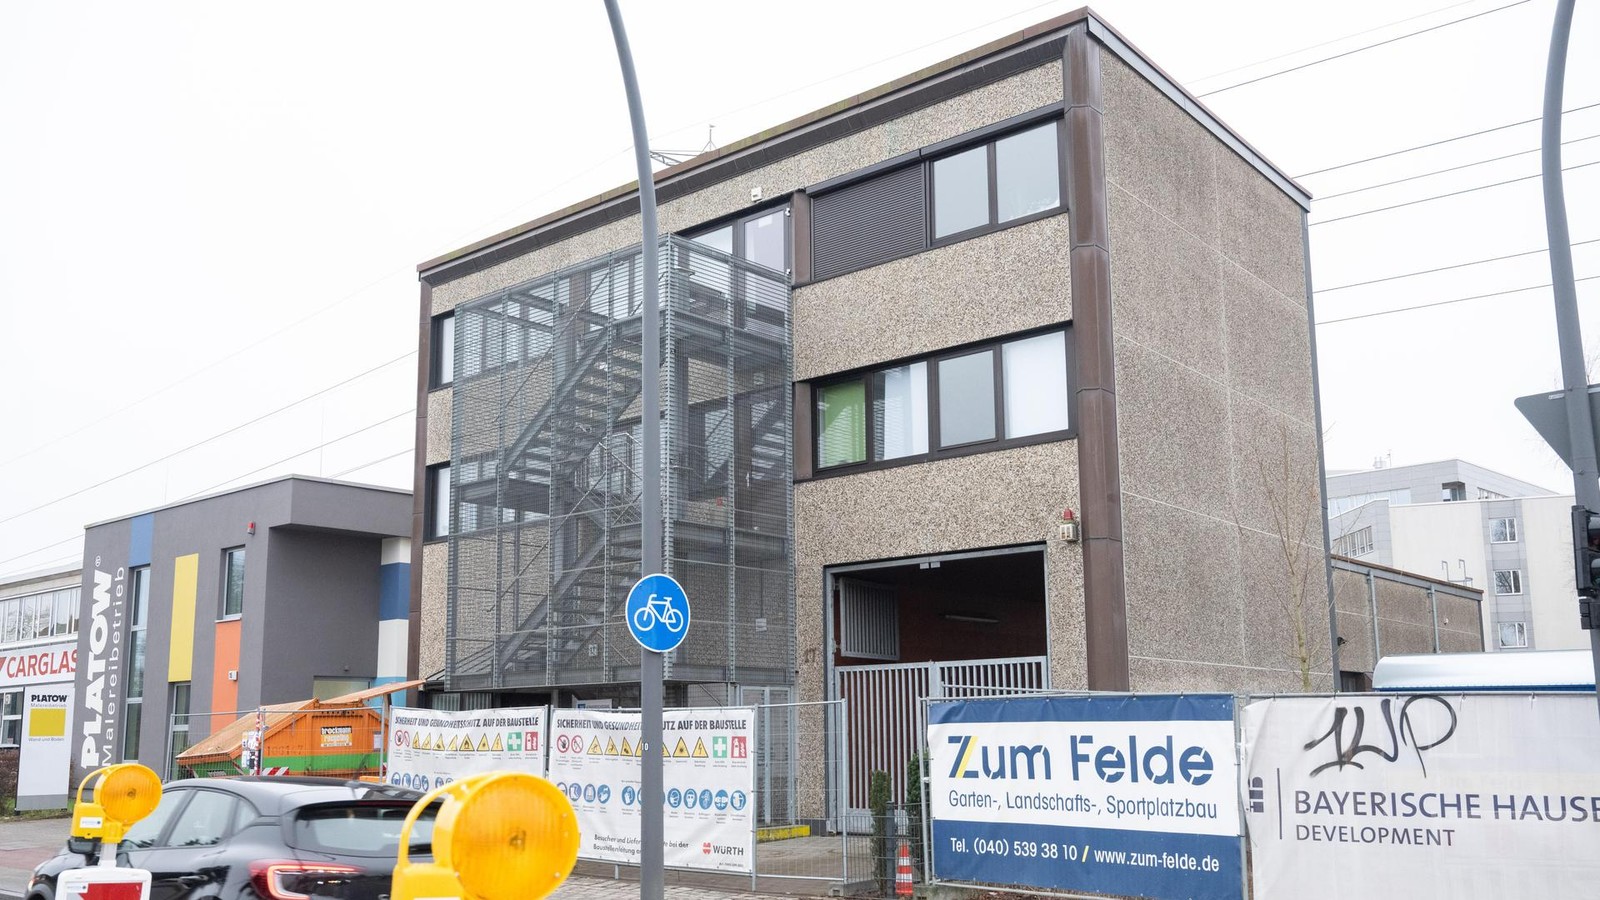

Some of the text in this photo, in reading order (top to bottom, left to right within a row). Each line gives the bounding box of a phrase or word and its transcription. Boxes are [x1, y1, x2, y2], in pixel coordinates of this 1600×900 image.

[102, 567, 125, 766] Malereibetrieb
[31, 694, 67, 702] PLATOW
[418, 718, 429, 727] UND
[482, 718, 495, 728] AUF
[496, 718, 507, 728] DER
[507, 717, 539, 727] BAUSTELLE
[557, 719, 592, 729] SICHERHEIT
[592, 720, 604, 730] UND
[678, 720, 693, 730] AUF
[695, 720, 708, 730] DER
[710, 719, 747, 730] BAUSTELLE
[948, 735, 1214, 786] Zum Felde
[949, 790, 1217, 820] Garten-, Landschafts-, Sportplatzbau
[1295, 790, 1481, 819] BAYERISCHE
[1297, 824, 1455, 846] DEVELOPMENT
[950, 838, 969, 853] Tel.
[974, 837, 1009, 857] (040)
[1013, 841, 1037, 858] 539
[1041, 843, 1058, 859] 38
[1062, 845, 1078, 861] 10
[1094, 850, 1220, 873] www.zum-felde.de
